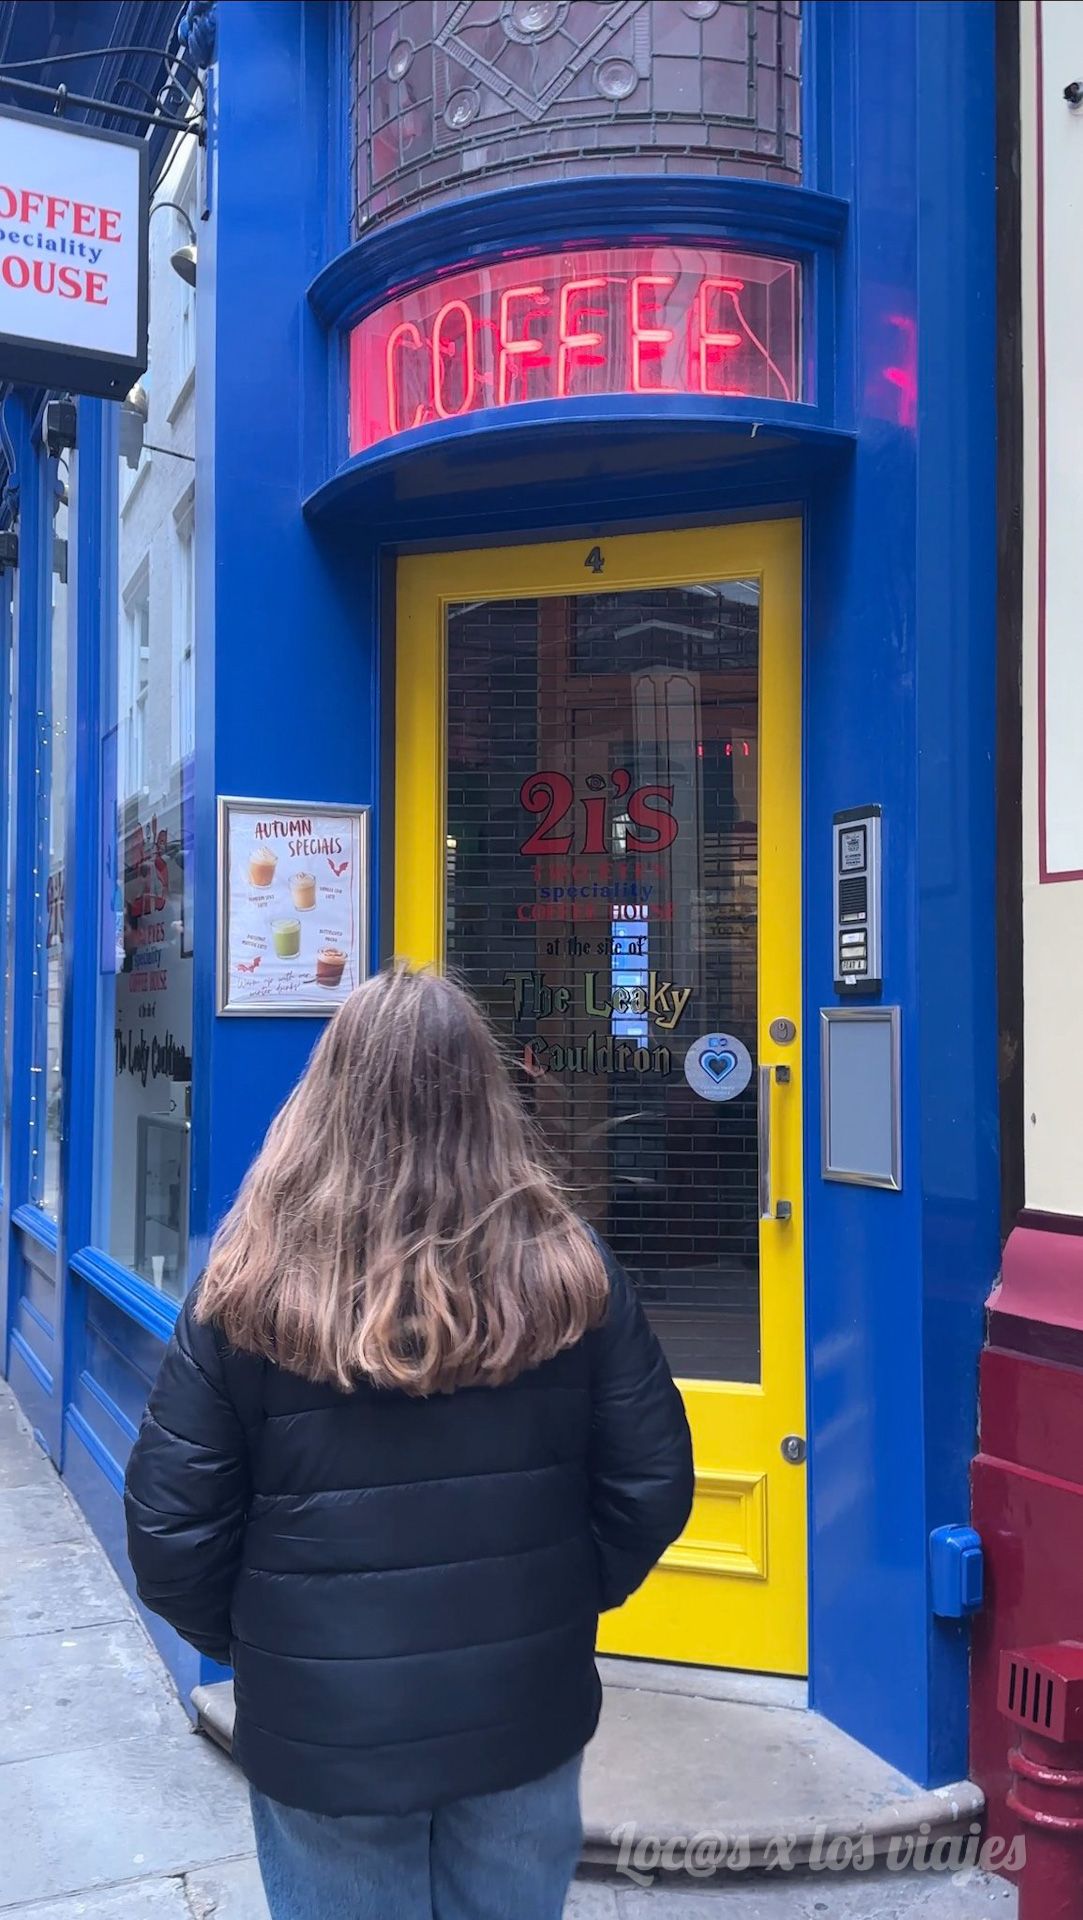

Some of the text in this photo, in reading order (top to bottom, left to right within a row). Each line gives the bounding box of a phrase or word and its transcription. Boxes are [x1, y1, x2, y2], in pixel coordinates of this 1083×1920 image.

[2, 255, 108, 306] OUSE
[386, 276, 745, 434] COFFEE
[584, 546, 605, 574] 4
[255, 819, 312, 841] AUTUMN
[288, 837, 343, 858] SPECIALS
[540, 881, 654, 902] speciality
[546, 935, 648, 957] at the site of
[503, 969, 694, 1030] The Leaky
[523, 1030, 672, 1078] Cauldron
